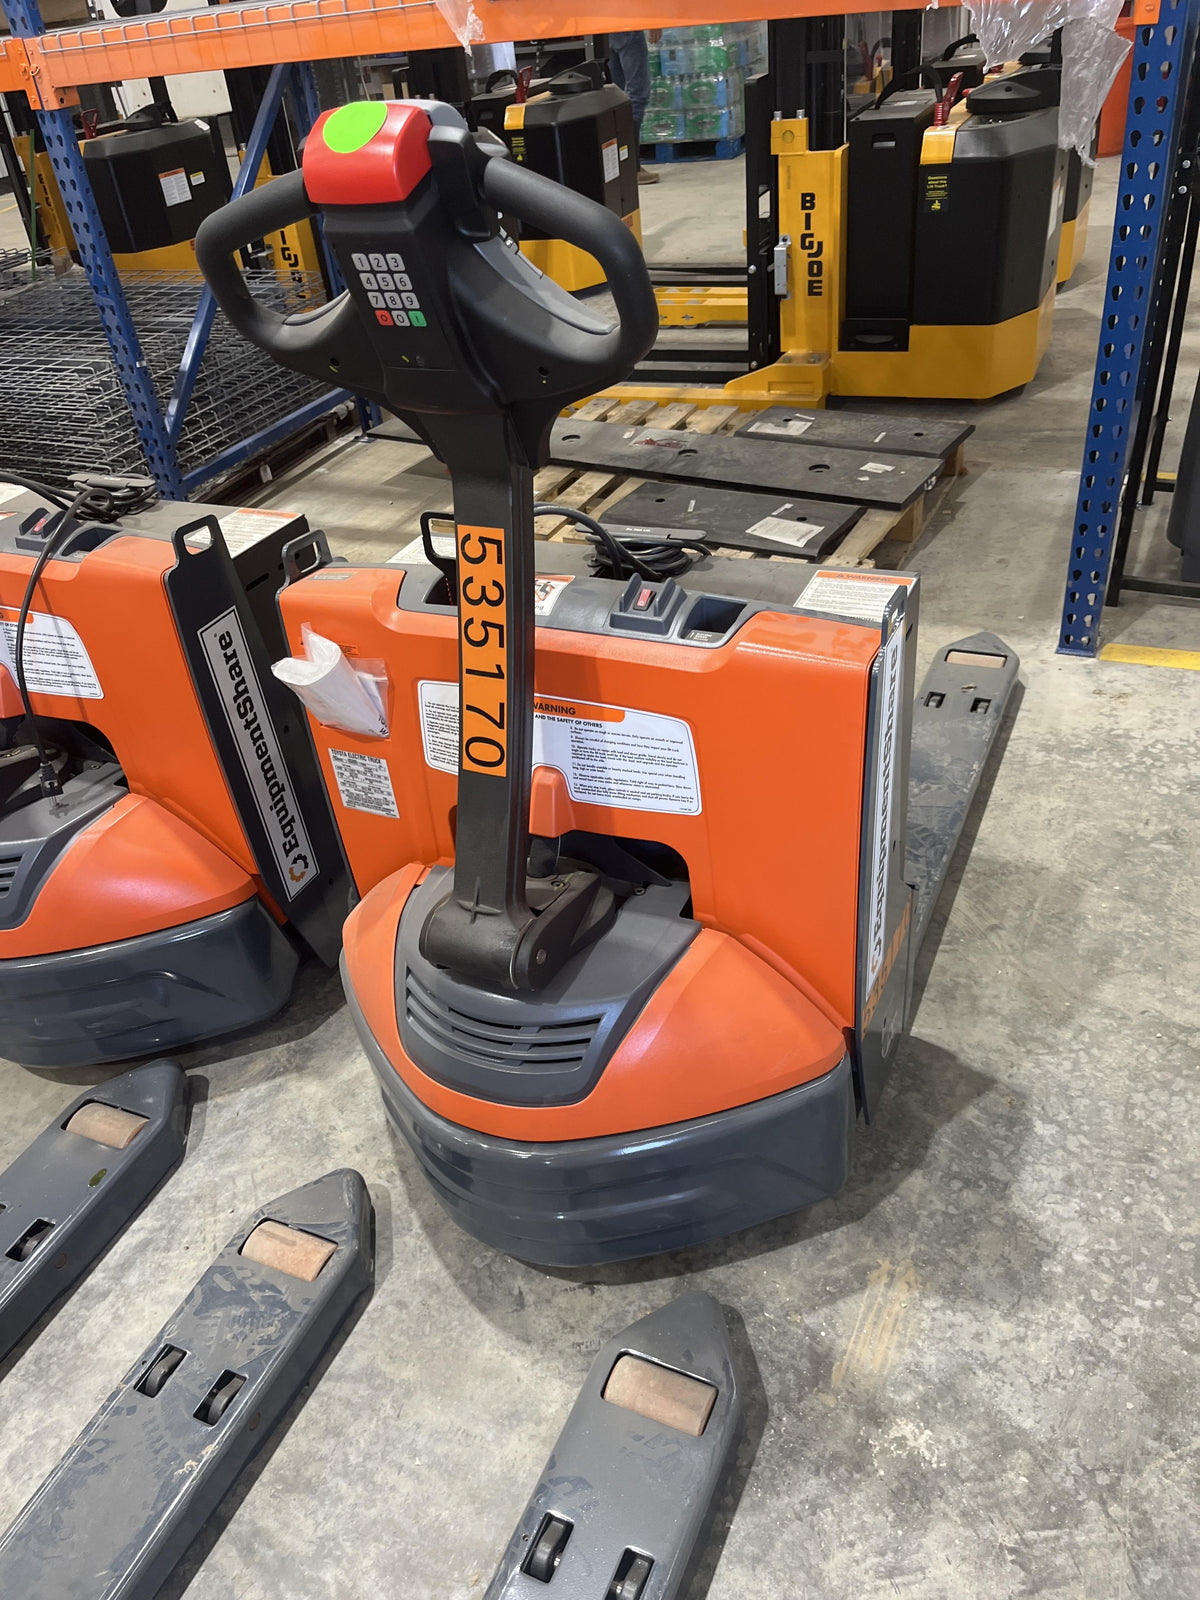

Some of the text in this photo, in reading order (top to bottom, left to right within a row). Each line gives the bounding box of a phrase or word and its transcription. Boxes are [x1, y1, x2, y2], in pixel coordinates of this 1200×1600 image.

[358, 257, 399, 268] 1 2 3
[366, 276, 407, 288] 4 5 6
[372, 295, 414, 306] 7 8 9
[460, 532, 505, 768] 535170
[583, 720, 603, 729] OTHERS
[217, 630, 301, 857] EquipmentShare
